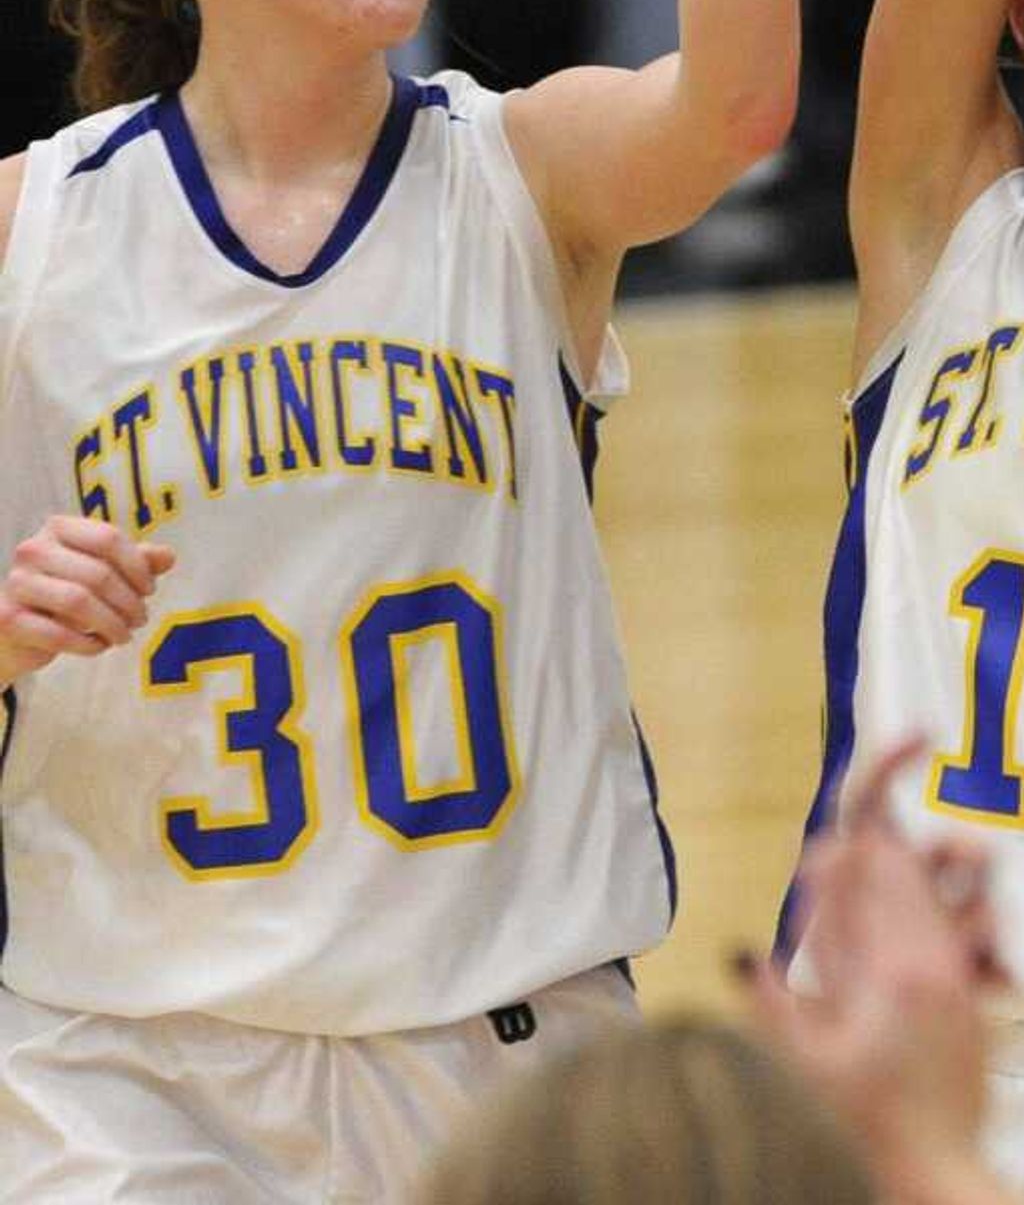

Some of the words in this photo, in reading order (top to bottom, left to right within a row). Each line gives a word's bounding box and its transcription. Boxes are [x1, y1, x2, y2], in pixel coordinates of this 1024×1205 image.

[70, 384, 178, 536] ST.
[180, 333, 518, 502] VINCENT
[144, 569, 521, 882] 30
